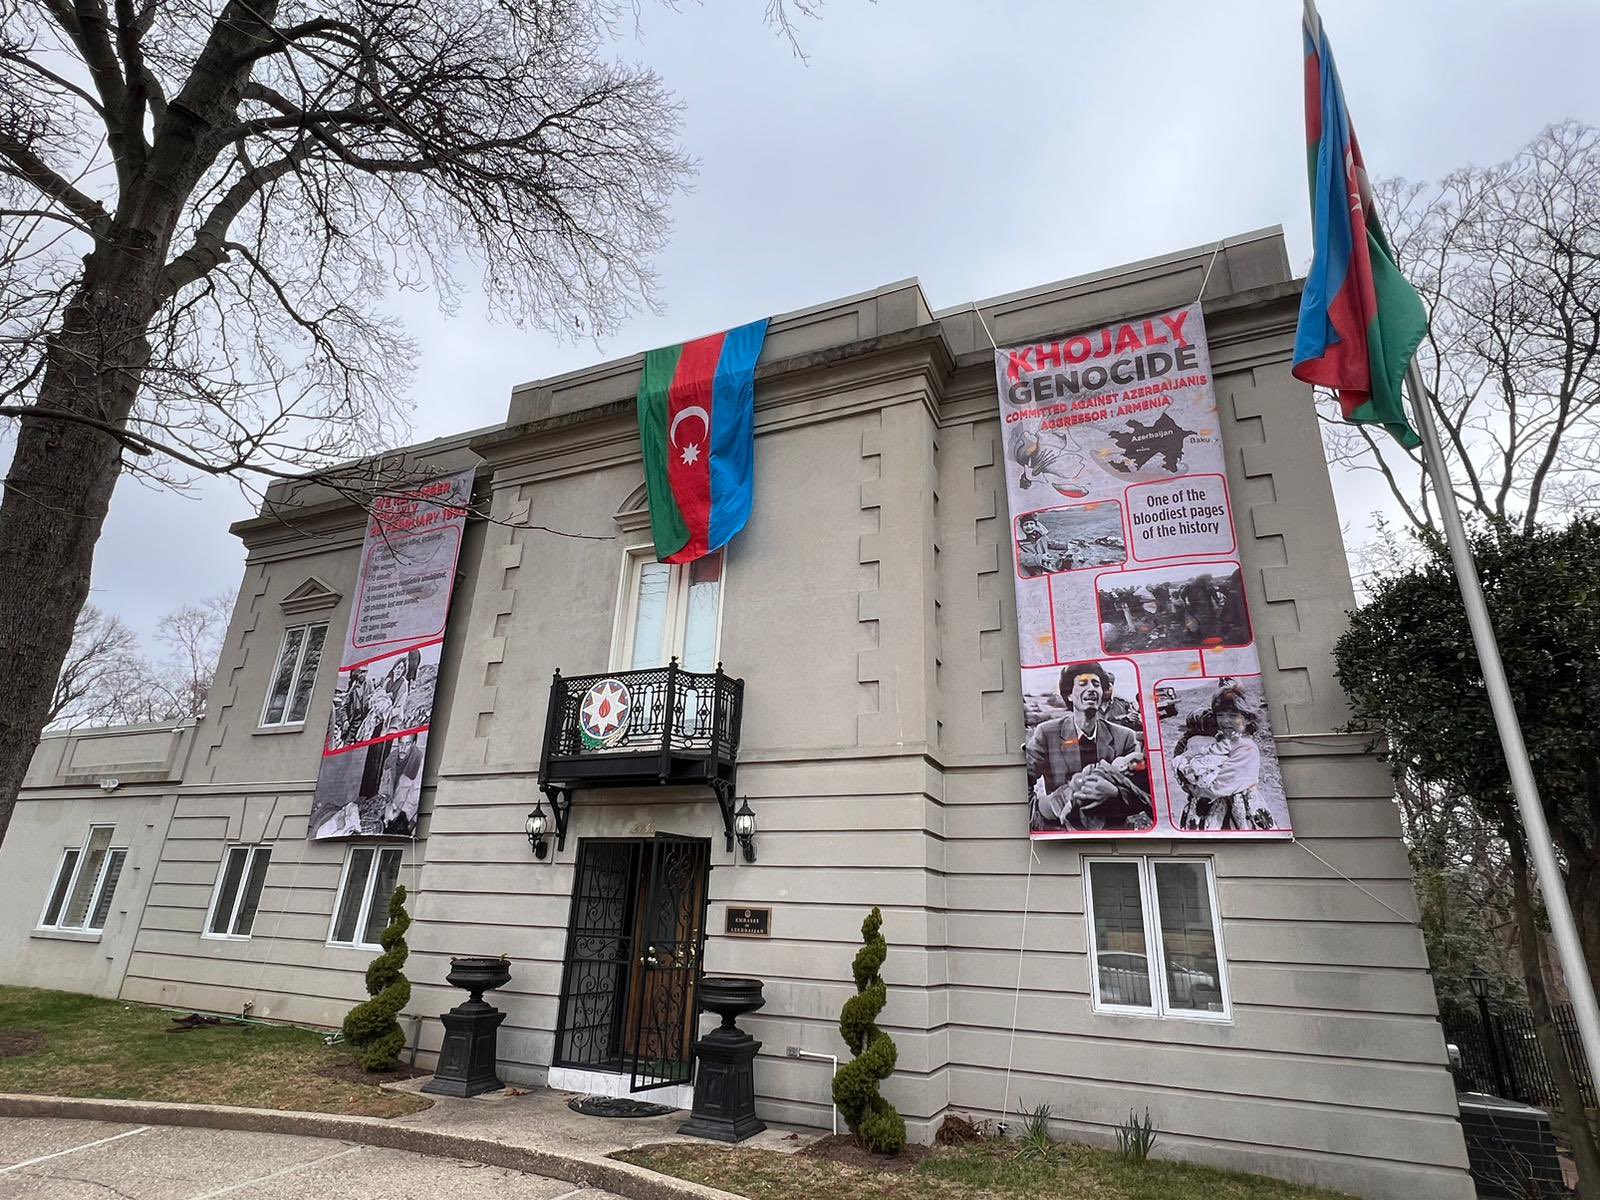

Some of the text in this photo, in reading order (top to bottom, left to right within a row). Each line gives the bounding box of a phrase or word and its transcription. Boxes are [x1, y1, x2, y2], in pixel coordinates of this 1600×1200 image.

[1007, 311, 1190, 378] KHOJALY
[1008, 344, 1199, 405] GENOCIDE
[1006, 374, 1208, 424] COMMITTED AGAINST AZERBAIJANIS
[1041, 410, 1109, 431] AGGRESSOR
[1116, 396, 1173, 417] ARMENIA
[1131, 428, 1174, 443] Azerbaijan
[1190, 436, 1210, 444] Baku
[1146, 488, 1206, 508] One of the
[1133, 504, 1224, 526] bloodiest pages
[1142, 519, 1220, 541] of the history
